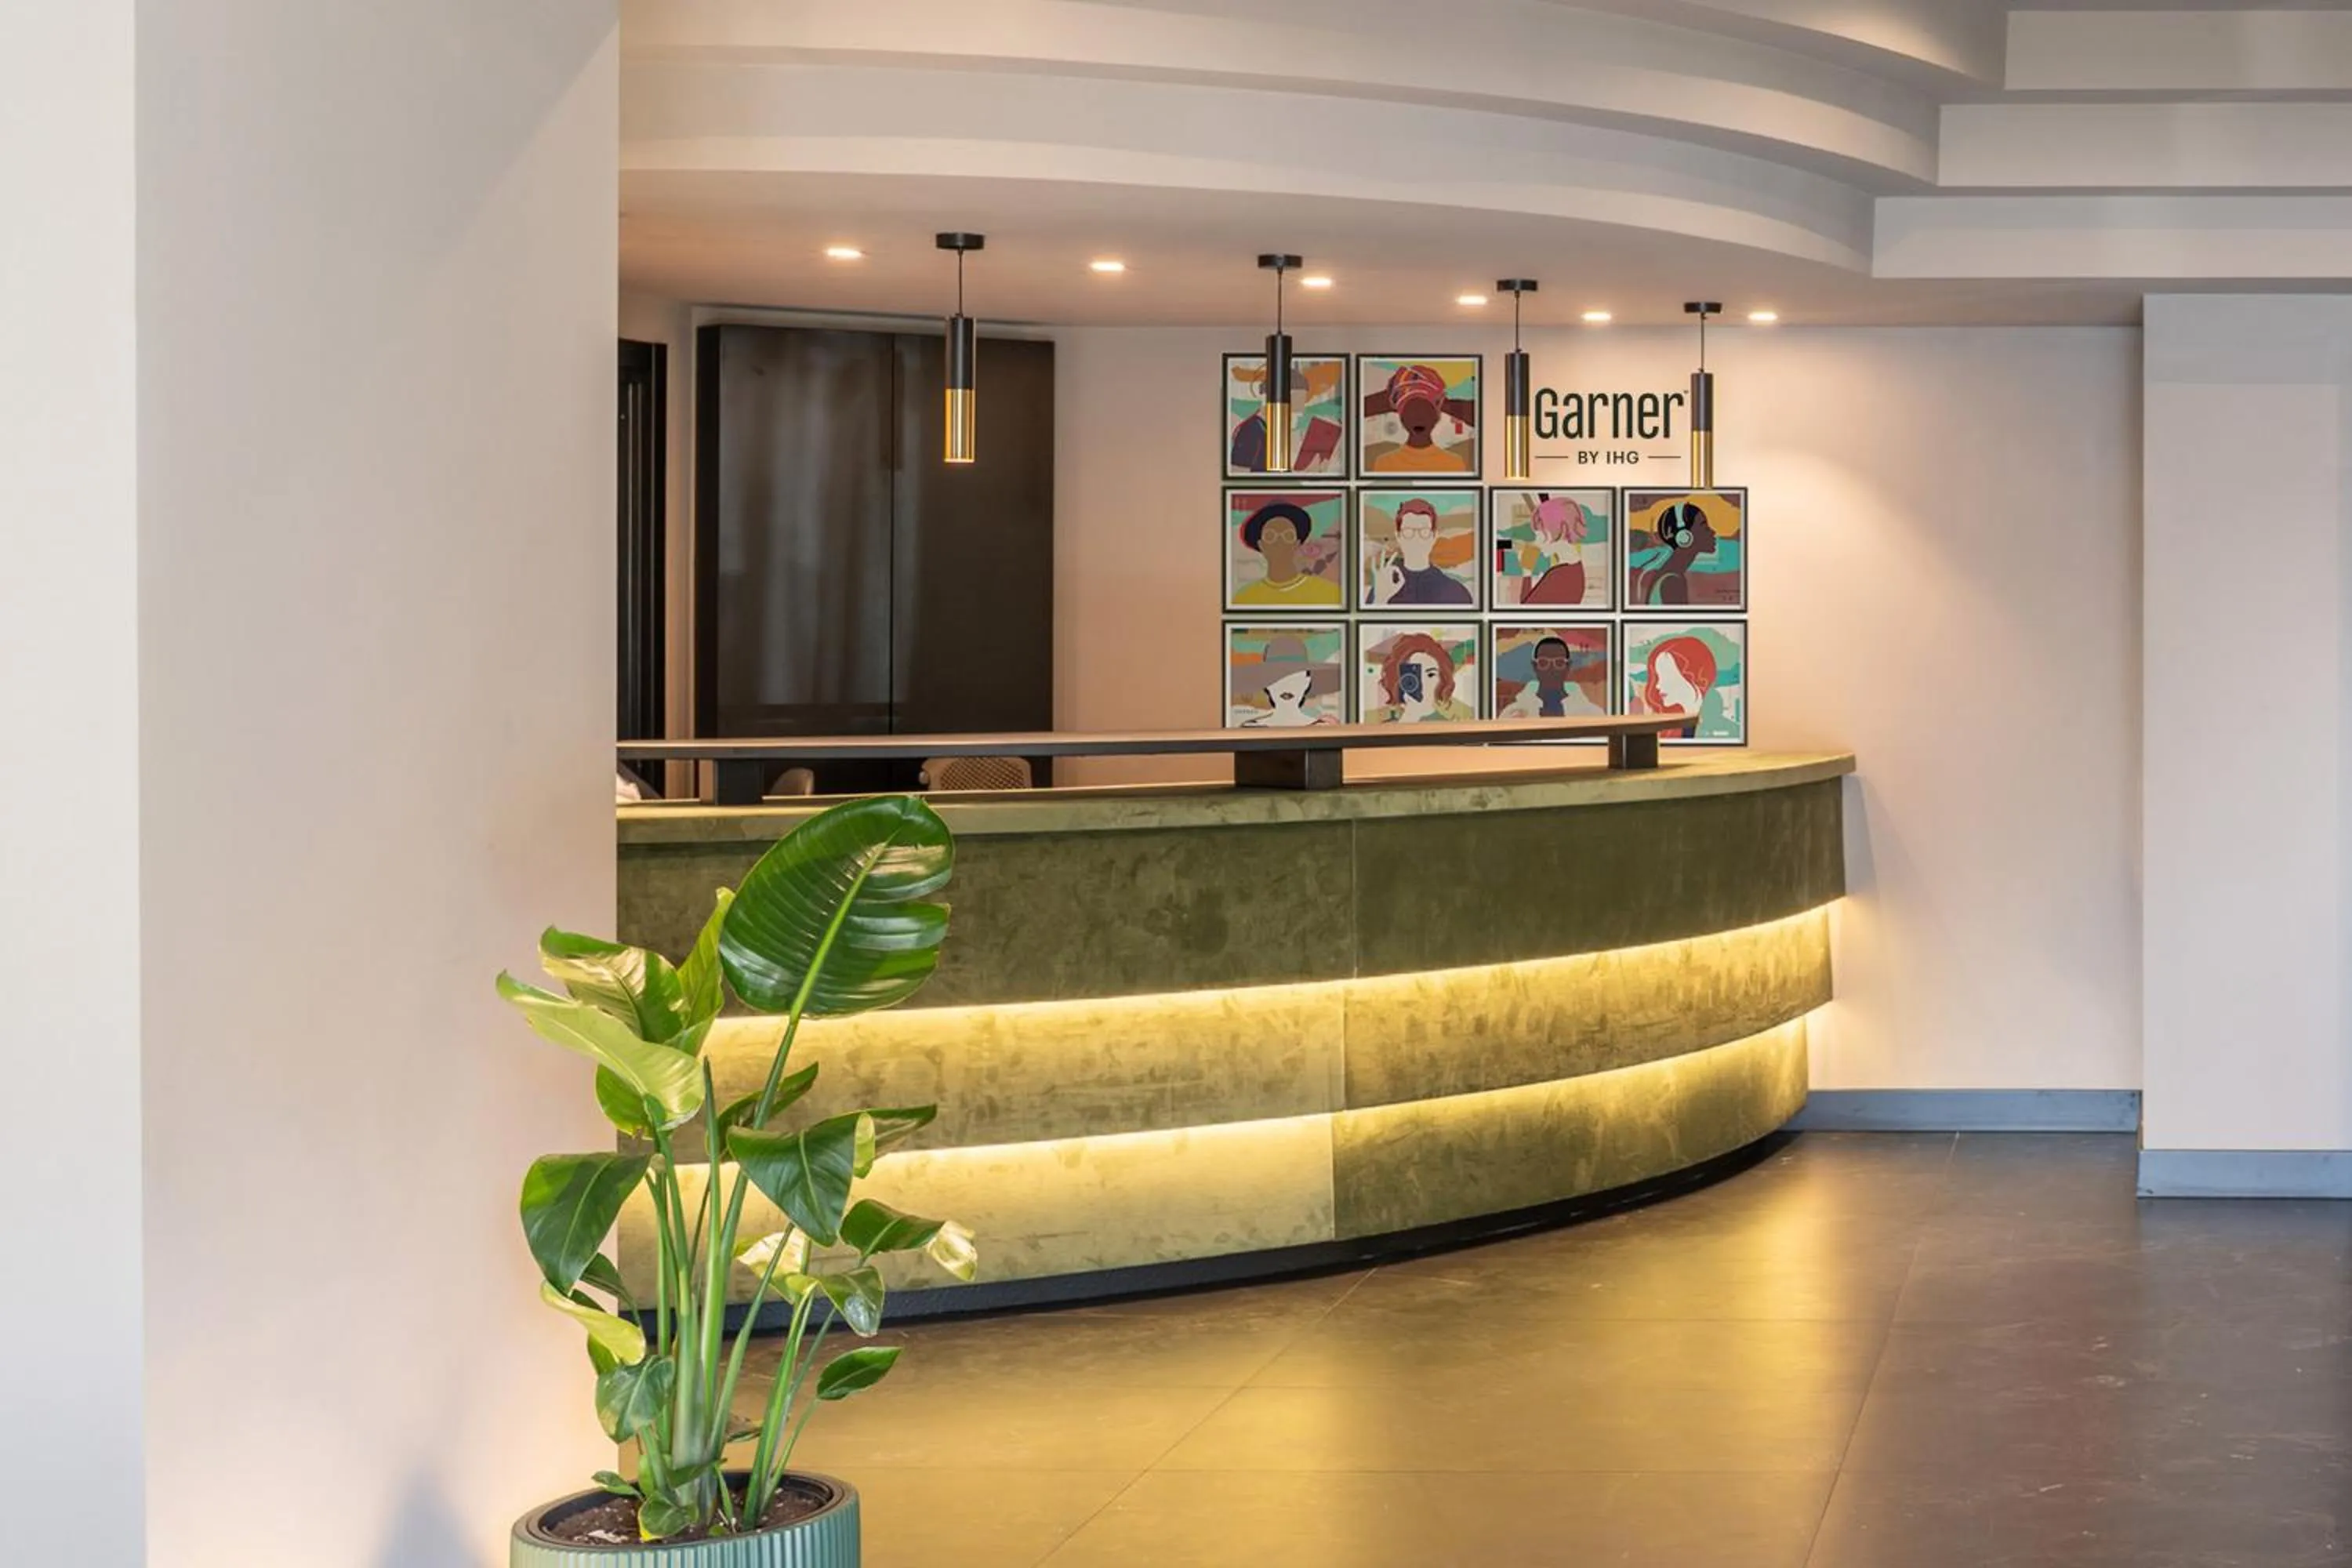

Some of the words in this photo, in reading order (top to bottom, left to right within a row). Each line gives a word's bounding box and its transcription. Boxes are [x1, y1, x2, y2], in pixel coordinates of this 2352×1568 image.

[1534, 388, 1685, 439] Garner
[1577, 451, 1599, 464] BY
[1606, 451, 1639, 464] IHG
